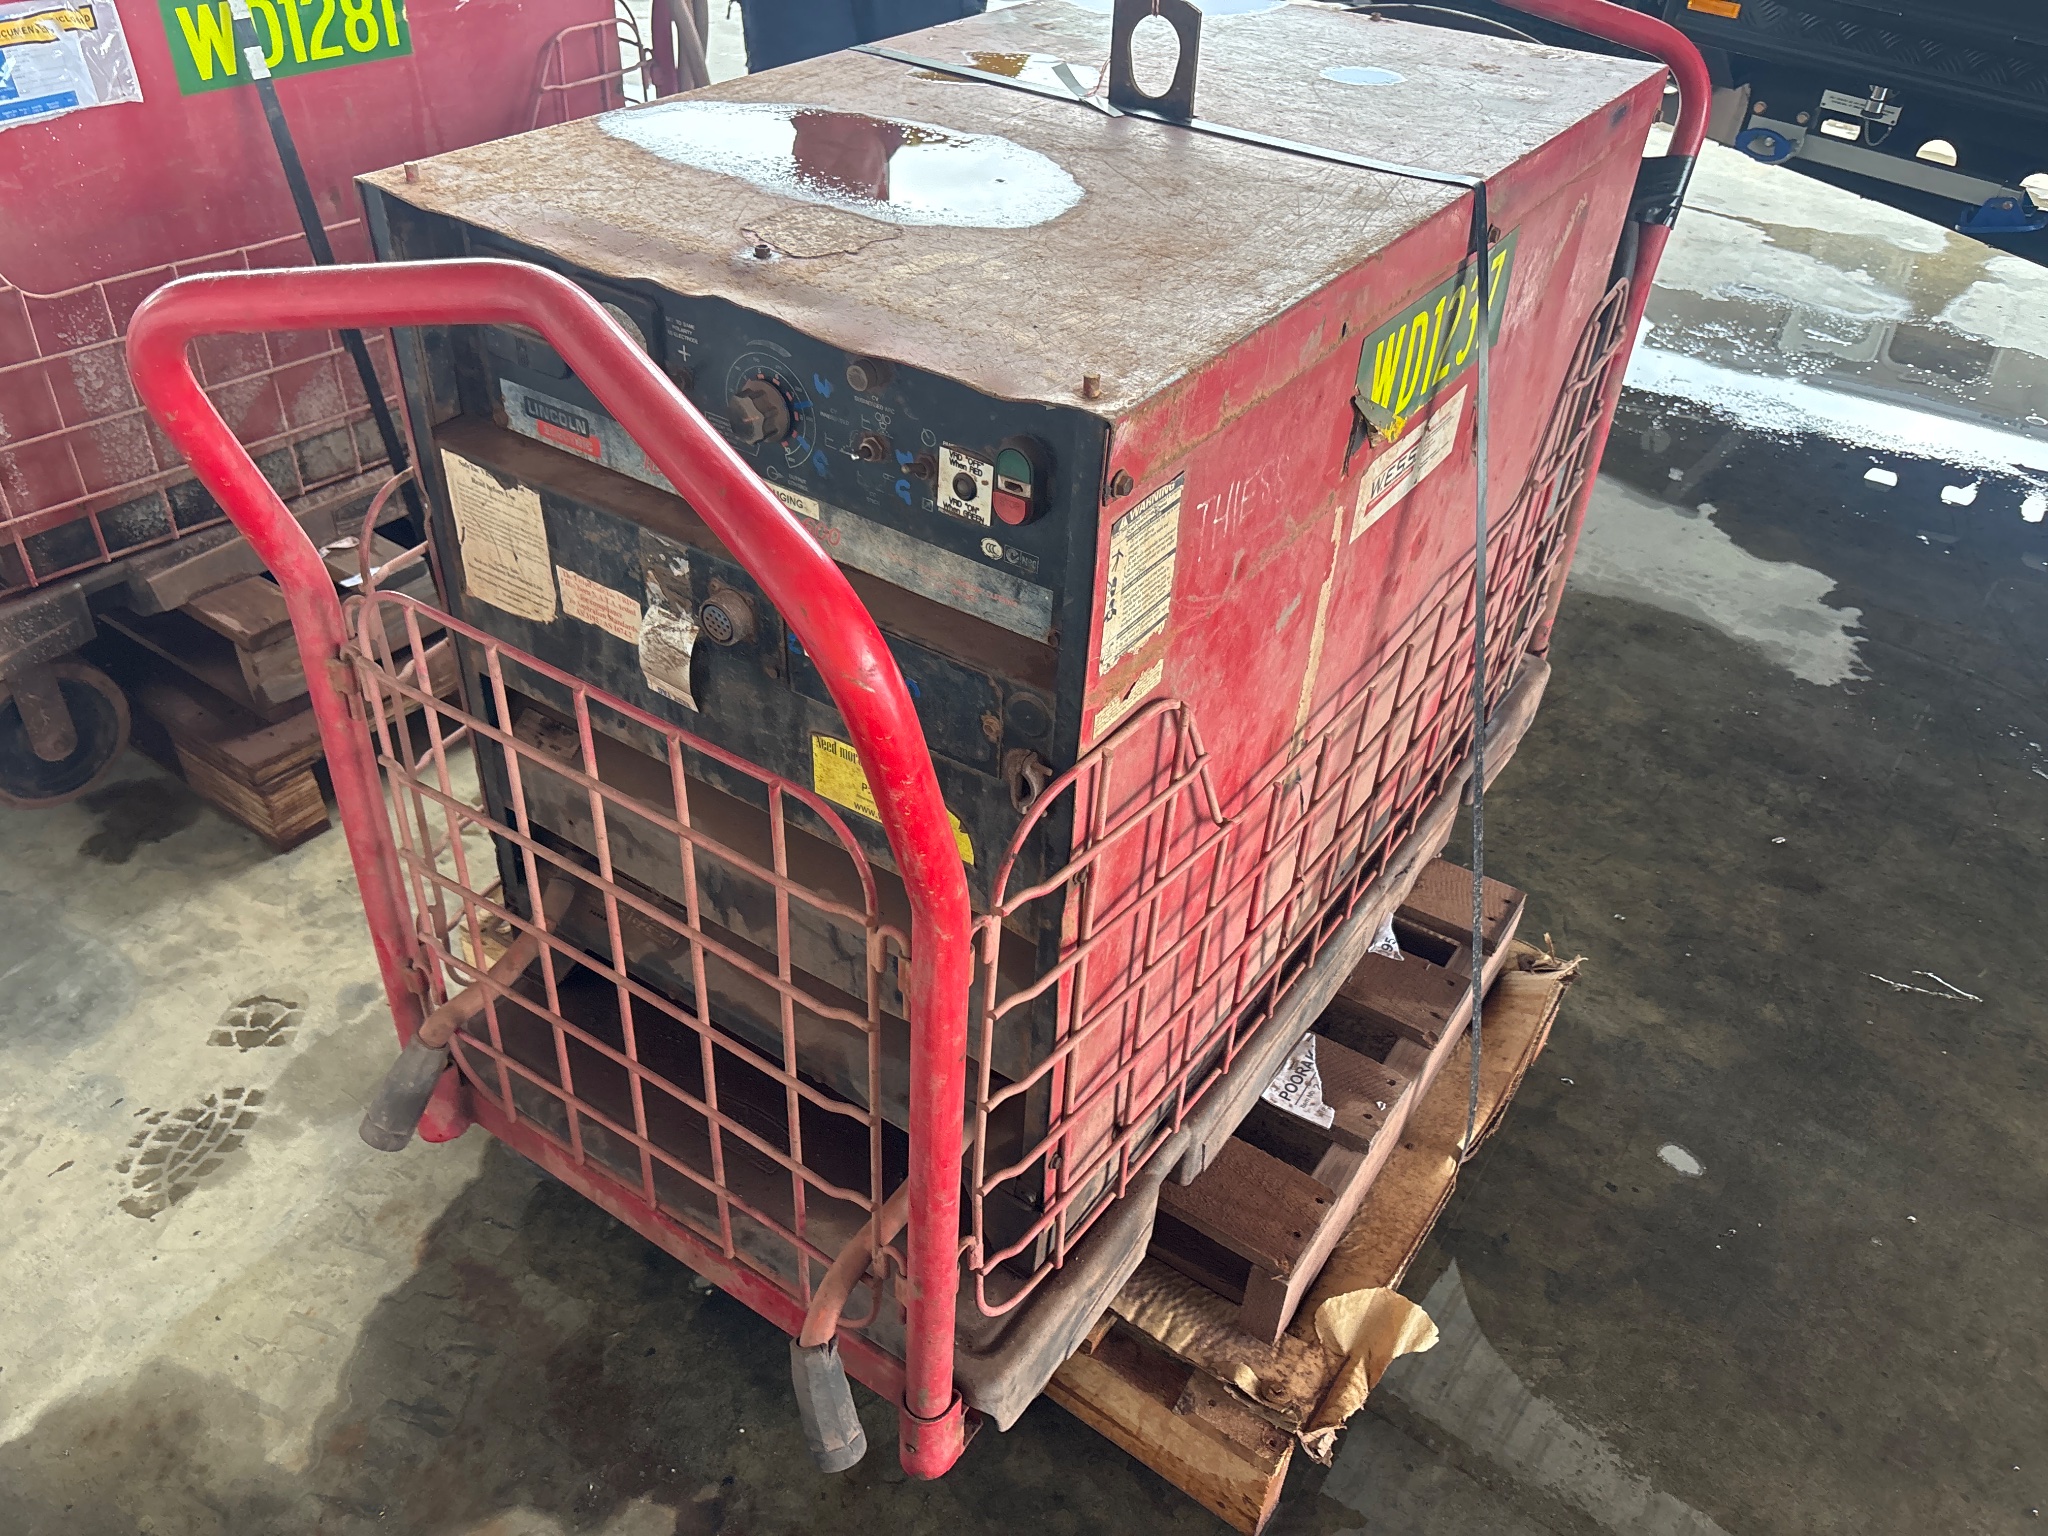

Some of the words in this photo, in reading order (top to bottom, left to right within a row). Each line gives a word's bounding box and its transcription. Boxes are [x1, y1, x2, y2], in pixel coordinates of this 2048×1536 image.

[526, 399, 587, 435] LINCOLN
[949, 450, 963, 461] VRD
[949, 458, 968, 471] When
[969, 465, 983, 477] RED
[942, 500, 964, 515] When
[948, 496, 962, 508] VRD
[1128, 483, 1176, 521] WARNING
